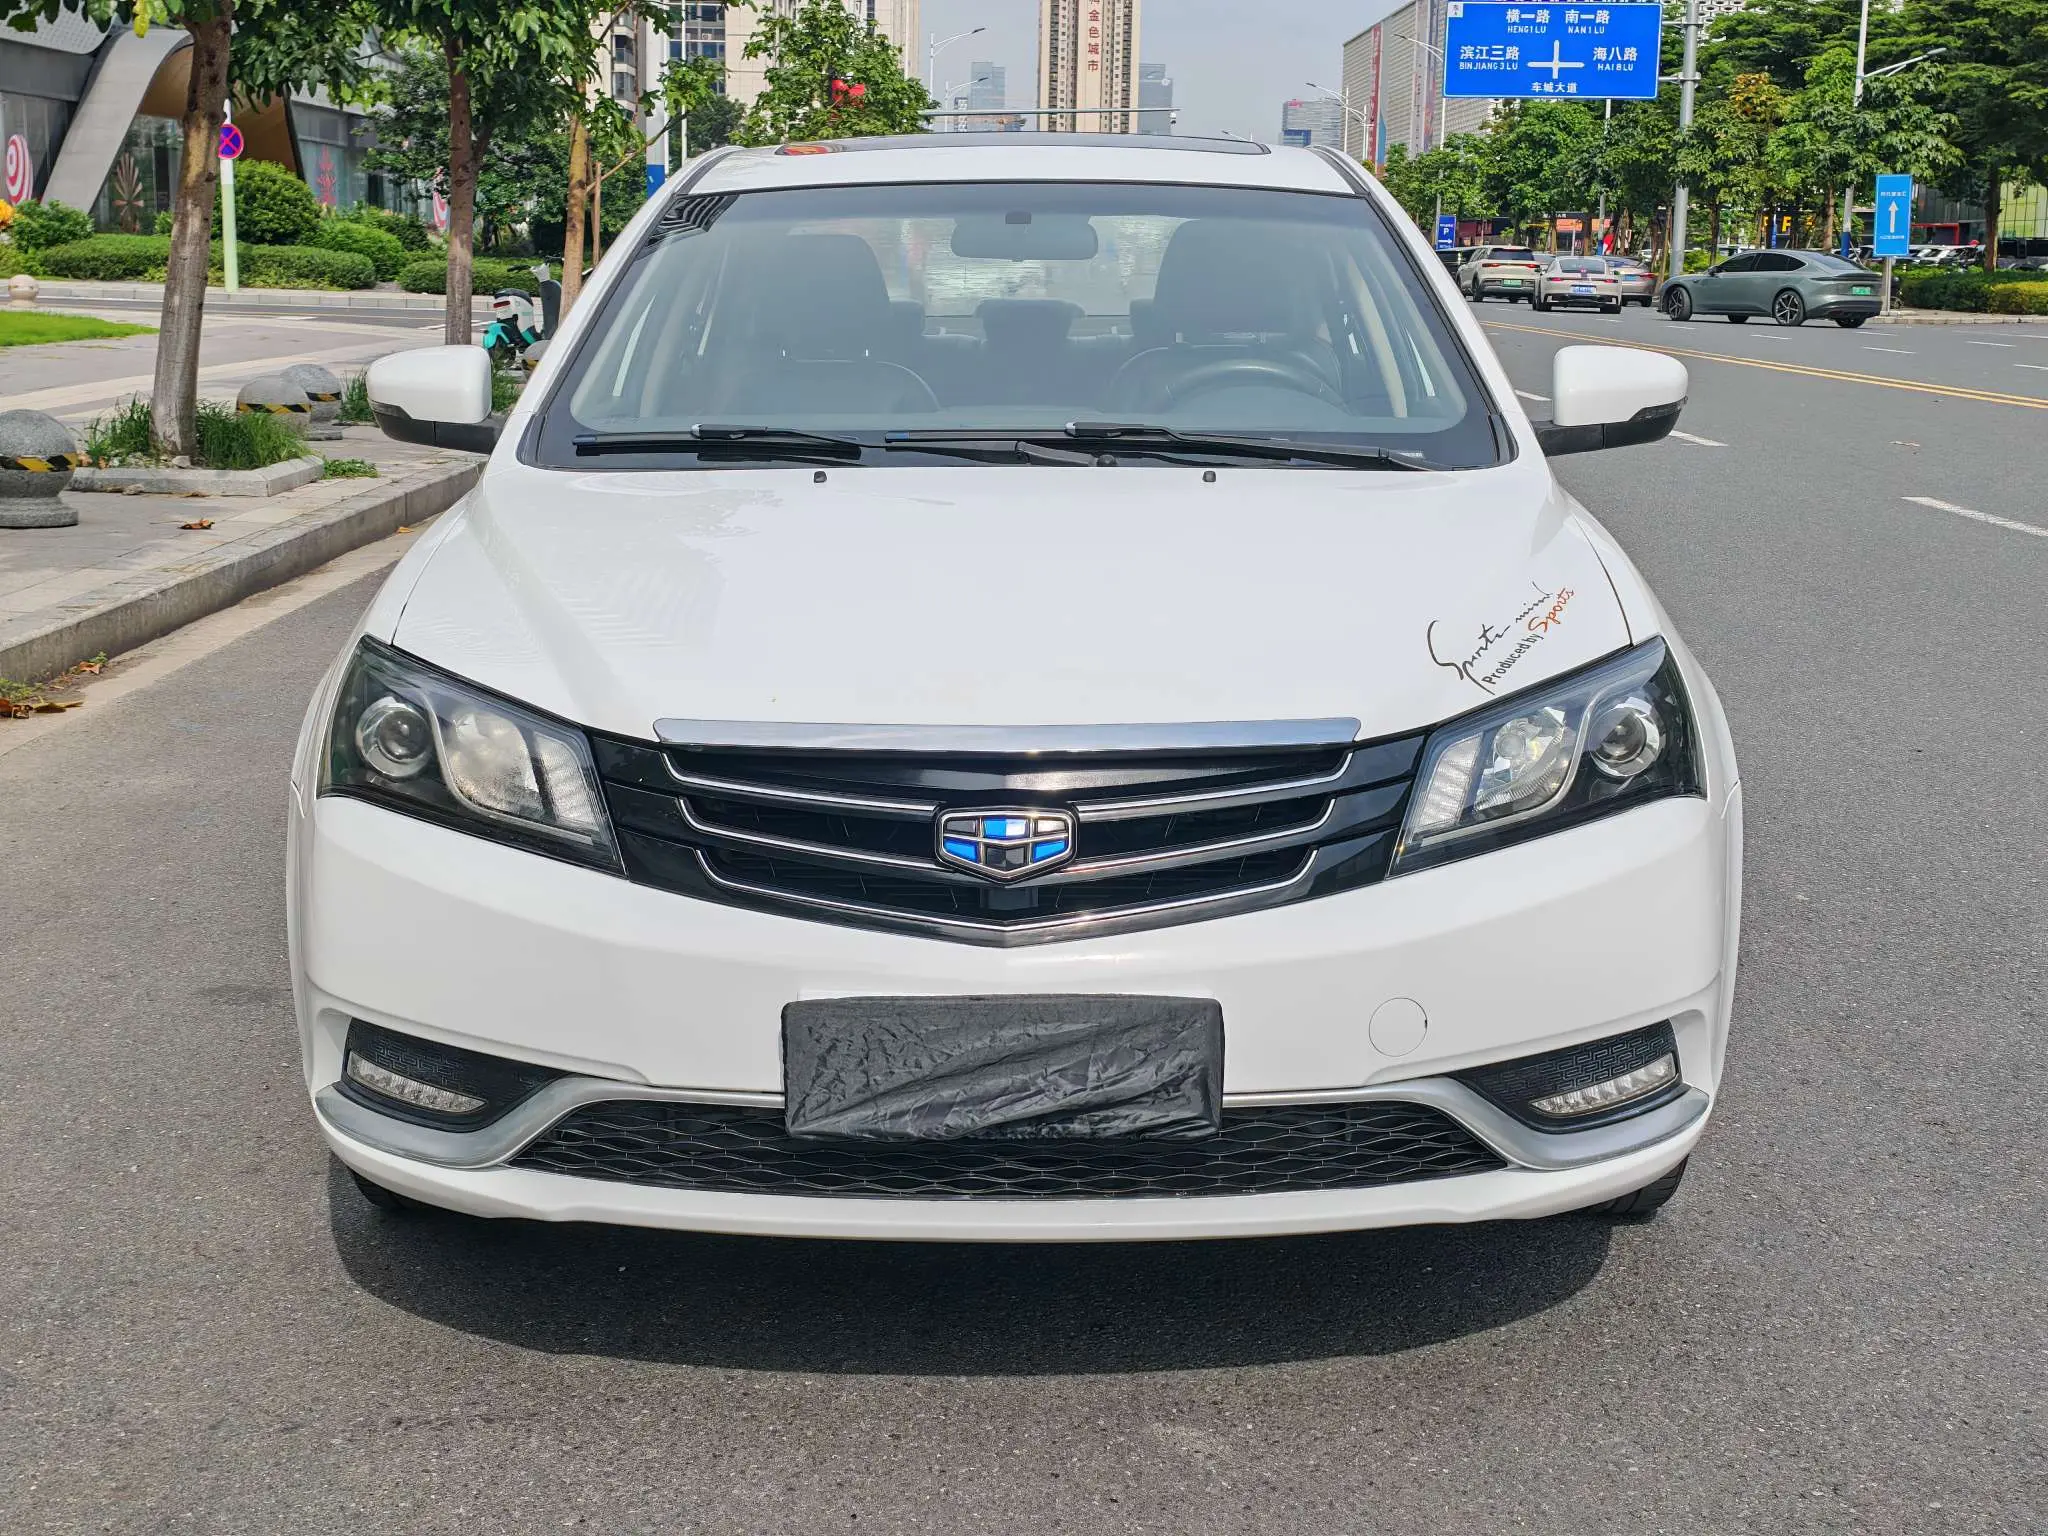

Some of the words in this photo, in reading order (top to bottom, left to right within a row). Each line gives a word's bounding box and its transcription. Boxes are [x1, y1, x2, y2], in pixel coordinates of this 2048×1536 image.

[1506, 9, 1550, 24] 横一路
[1565, 9, 1610, 24] 南一路
[1460, 45, 1519, 60] 滨江三路
[1593, 46, 1637, 61] 海八路
[1527, 587, 1575, 633] Sports
[1523, 632, 1545, 645] by
[1481, 641, 1531, 685] Produced
